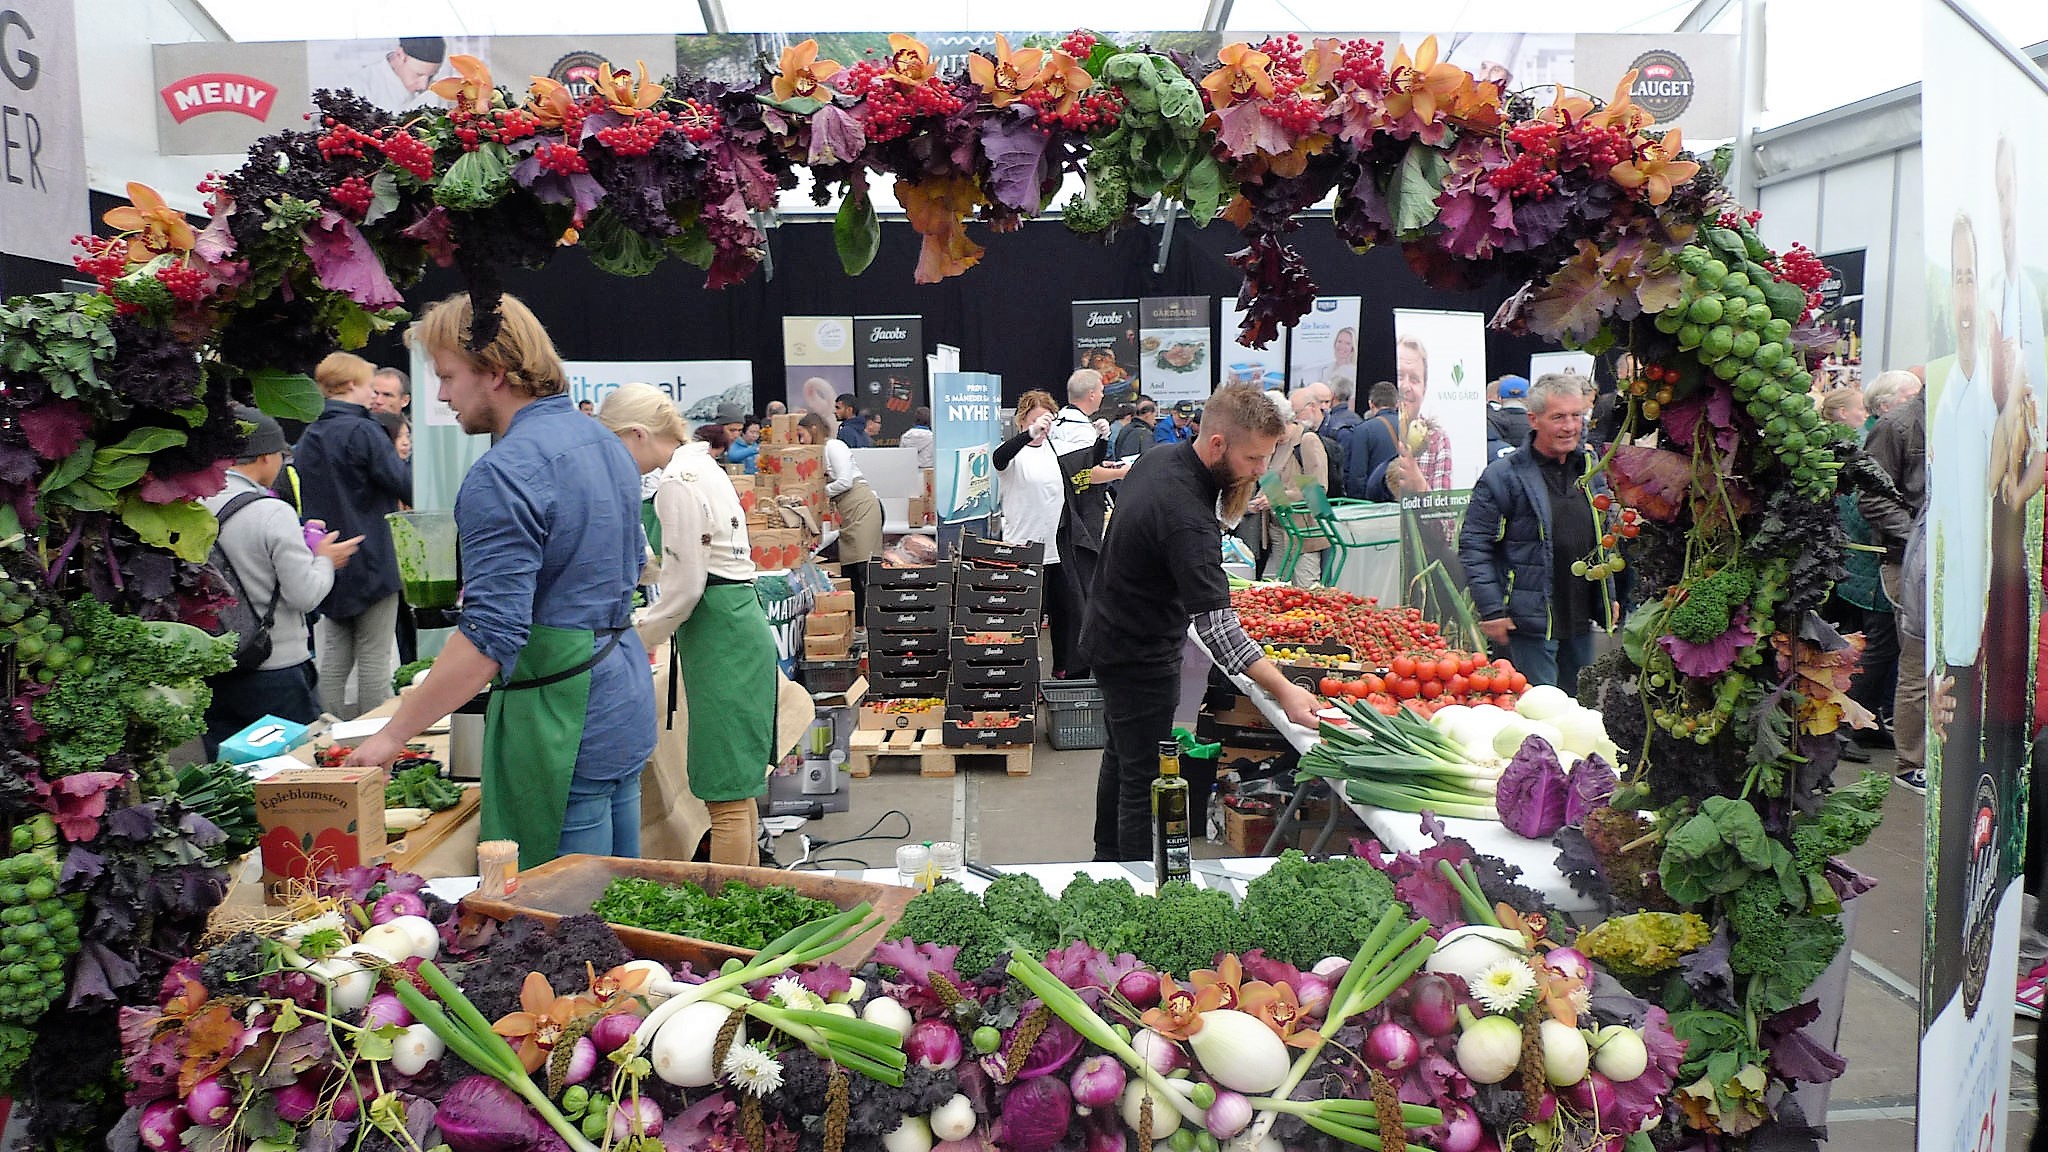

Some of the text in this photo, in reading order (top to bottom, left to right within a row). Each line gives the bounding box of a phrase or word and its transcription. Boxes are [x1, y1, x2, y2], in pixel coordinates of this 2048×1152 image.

[0, 9, 41, 91] G
[173, 82, 267, 111] MENY
[1628, 80, 1692, 96] LAUGET
[0, 105, 47, 193] ER
[1087, 311, 1123, 327] Jacobs
[870, 326, 908, 342] Jacobs
[1402, 494, 1471, 510] Godt til det mest
[260, 788, 349, 810] Epleblomsten
